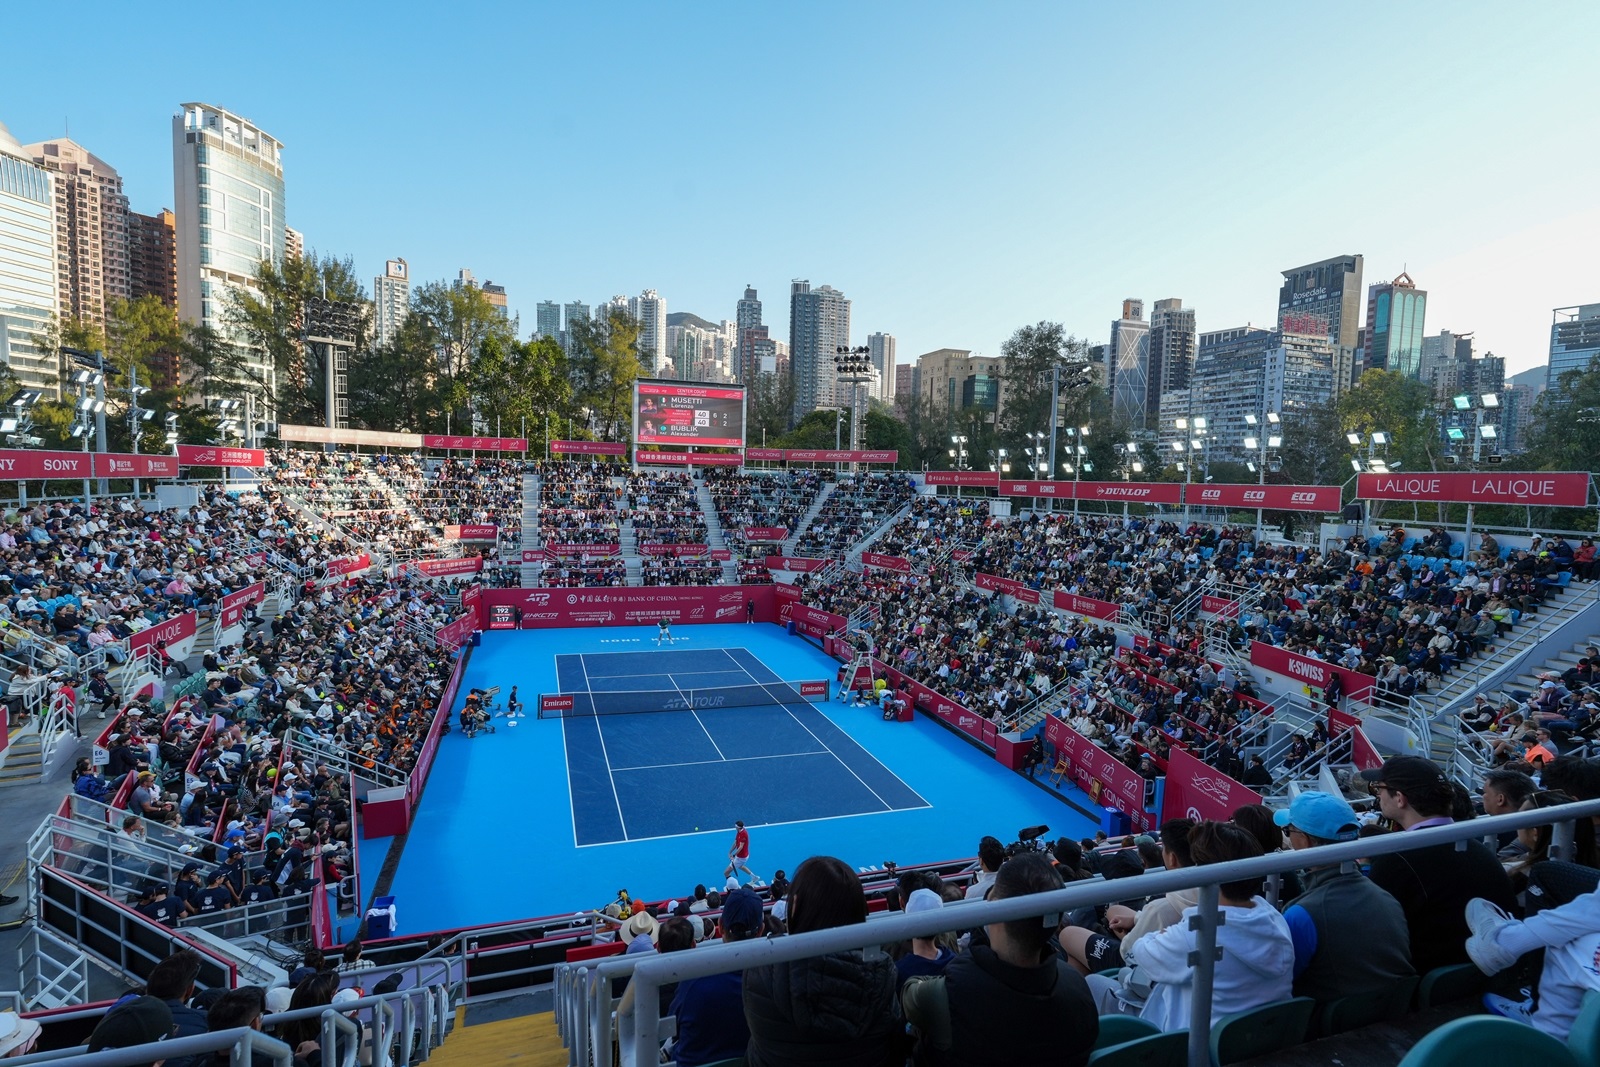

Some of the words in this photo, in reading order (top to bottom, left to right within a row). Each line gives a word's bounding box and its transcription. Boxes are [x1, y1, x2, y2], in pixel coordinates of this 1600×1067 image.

[1293, 287, 1327, 299] Rosedale
[44, 459, 78, 470] SONY
[1105, 488, 1151, 496] DUNLOP
[1376, 480, 1440, 494] LALIQUE
[1472, 480, 1555, 497] LALIQUE
[1243, 491, 1265, 499] ECO
[1291, 492, 1317, 501] ECO
[526, 593, 550, 601] ATP
[151, 623, 181, 646] LALIQUE
[809, 626, 822, 635] HONG
[694, 696, 724, 707] TOUR
[1103, 787, 1125, 812] KONG
